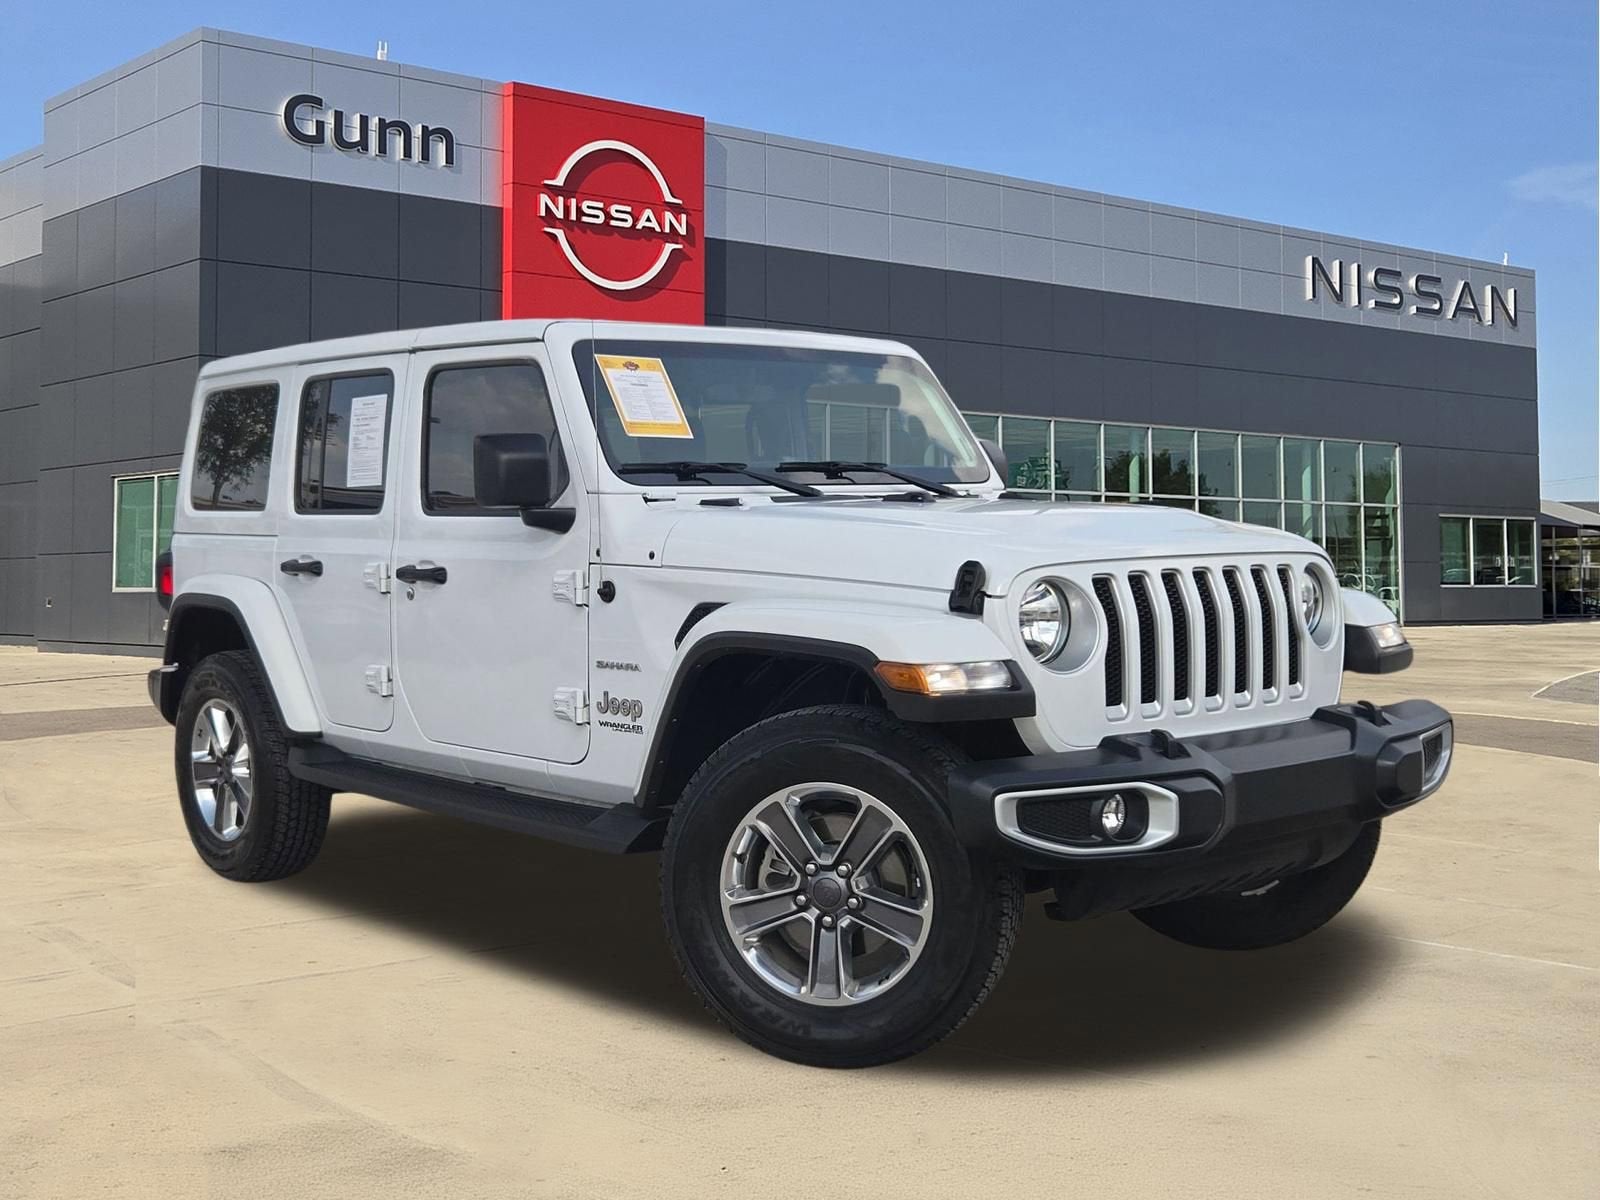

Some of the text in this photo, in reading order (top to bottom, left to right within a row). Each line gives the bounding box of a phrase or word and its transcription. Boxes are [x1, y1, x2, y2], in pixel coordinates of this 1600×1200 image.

[282, 93, 457, 167] Gunn
[537, 193, 687, 236] NISSAN
[1305, 255, 1518, 328] NISSAN
[596, 660, 642, 672] SAHARA
[596, 690, 643, 722] Jeep
[598, 720, 643, 732] WRANGLER
